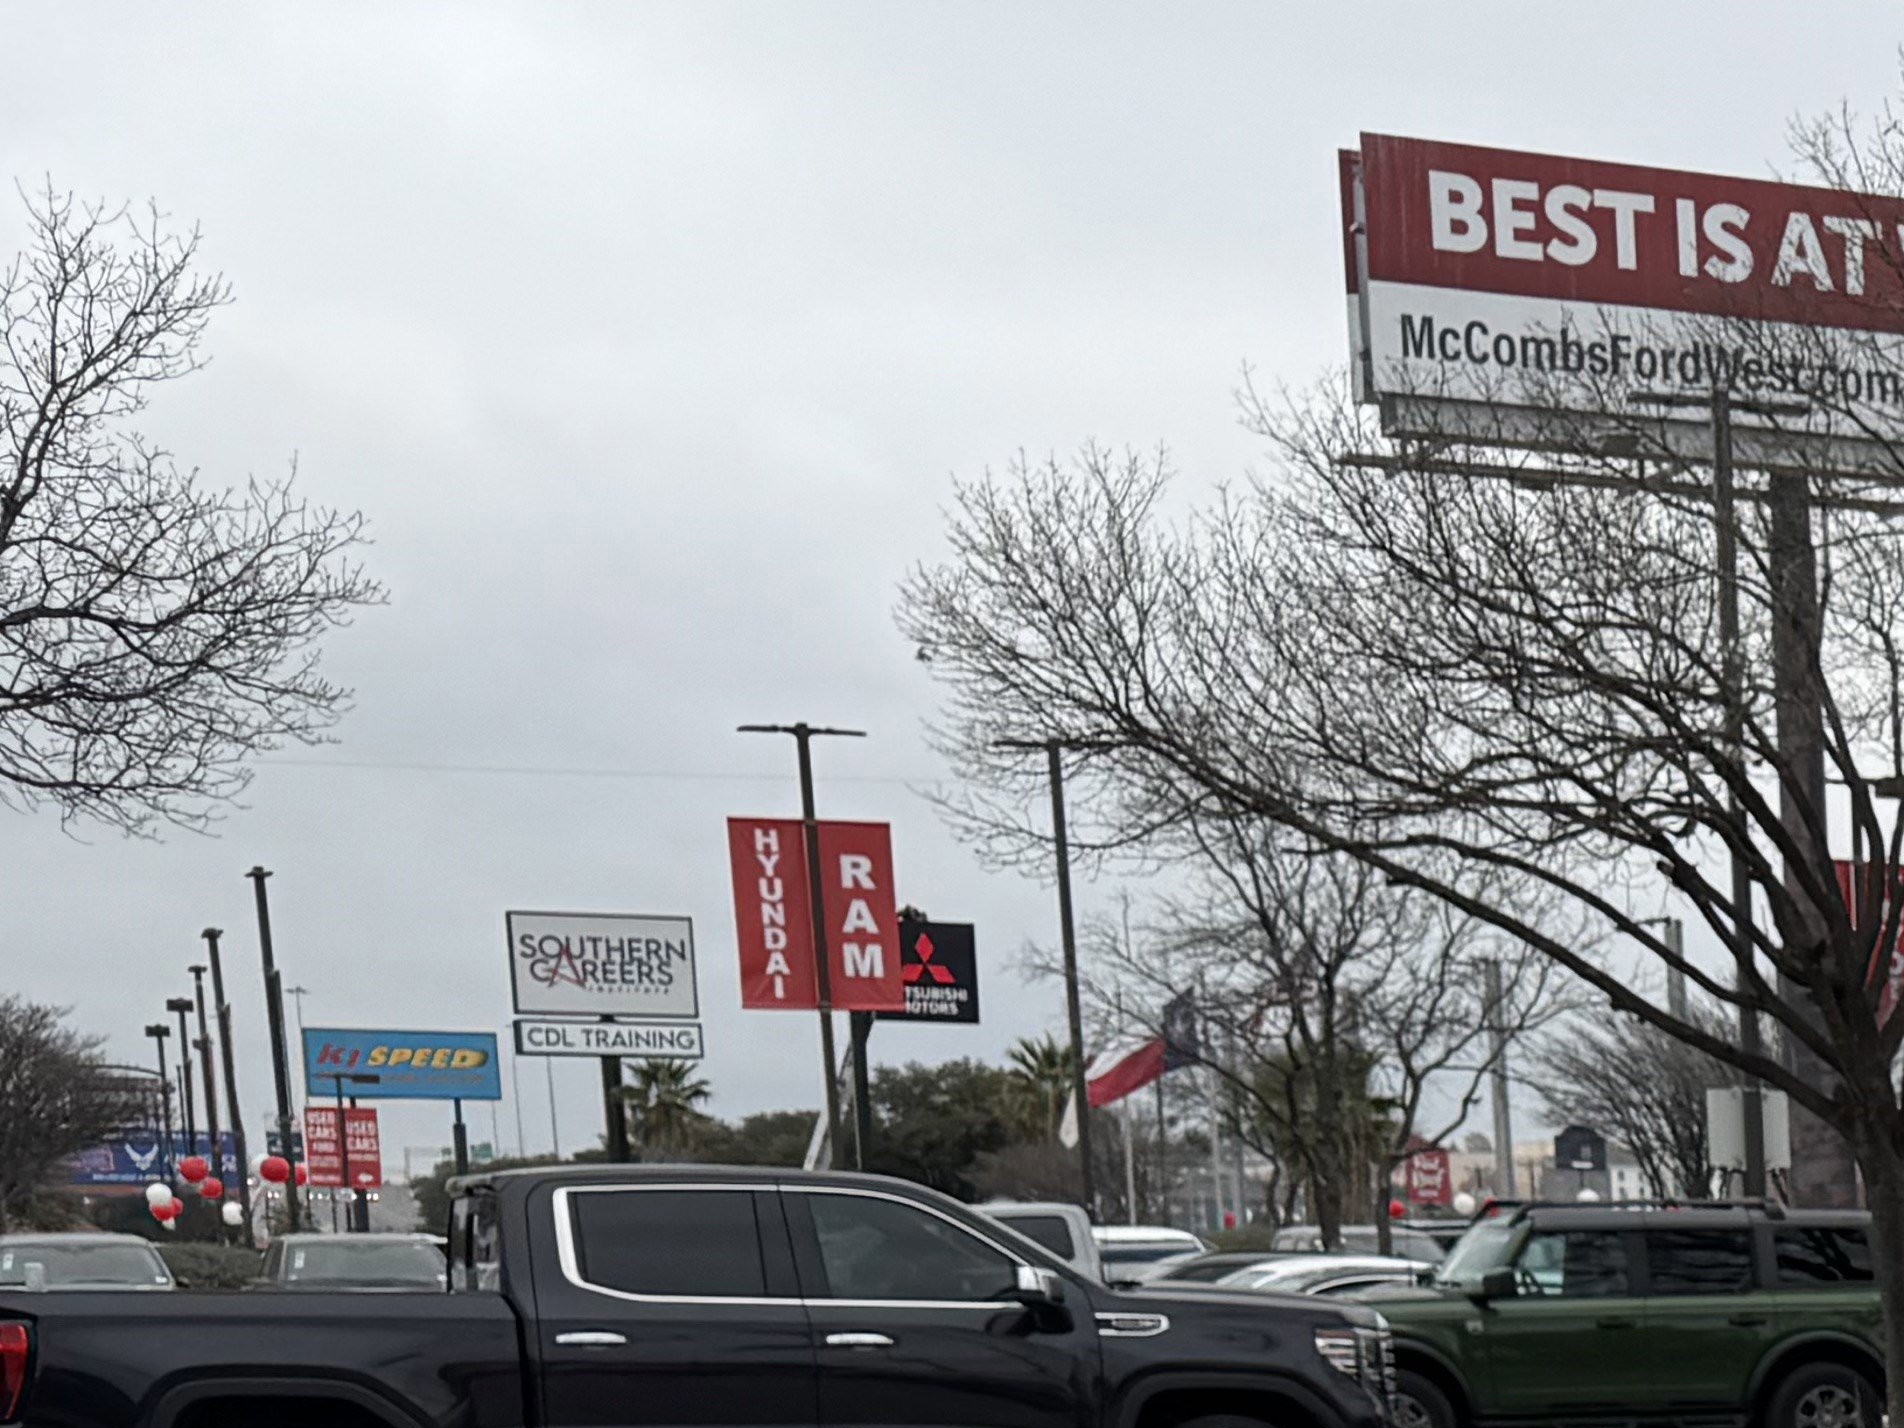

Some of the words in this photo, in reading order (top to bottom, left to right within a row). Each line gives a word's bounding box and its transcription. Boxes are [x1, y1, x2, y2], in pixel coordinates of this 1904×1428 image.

[1428, 169, 1655, 271] BEST
[1676, 198, 1755, 283] IS
[1771, 212, 1883, 296] AT
[754, 828, 791, 999] HYUNDAI
[839, 853, 885, 978] RAM
[519, 933, 687, 961] SOUTHERN
[529, 947, 674, 988] CAREERS
[904, 985, 968, 1002] TSUBISHI
[527, 1026, 575, 1047] CDL
[580, 1028, 696, 1050] TRAINING
[367, 1046, 489, 1070] SPEED
